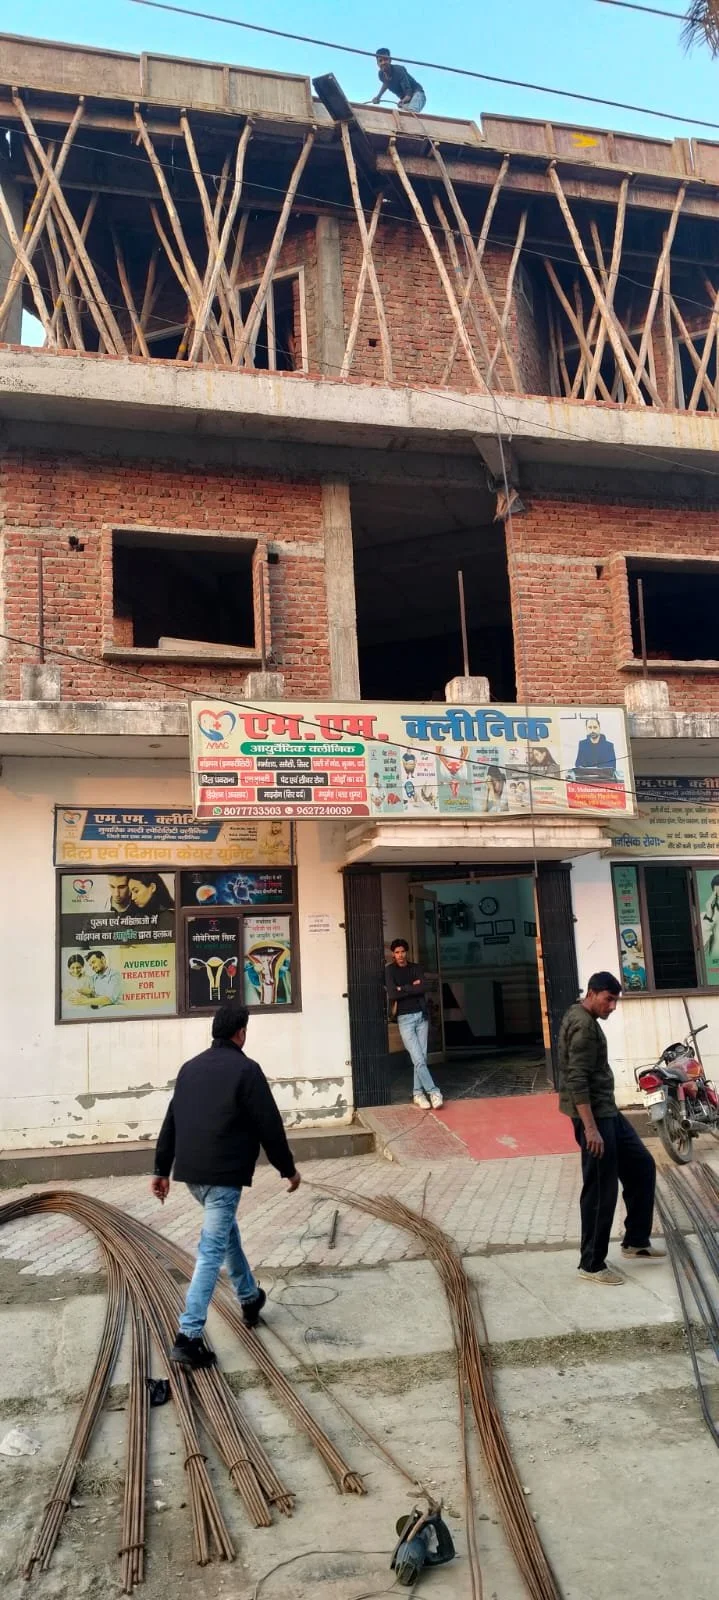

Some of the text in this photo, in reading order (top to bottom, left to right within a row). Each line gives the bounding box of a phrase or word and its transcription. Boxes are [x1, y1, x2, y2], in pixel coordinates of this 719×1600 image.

[239, 708, 552, 742] एम.एम. क्लीनिक
[250, 743, 356, 755] आयुर्वेदिक क्लीनिक
[223, 806, 282, 816] 8077733503
[296, 806, 353, 816] 9627240039
[93, 814, 149, 824] एम.एम.
[62, 842, 92, 860] दिल
[123, 842, 172, 860] दिमाग
[175, 844, 214, 860] केयर
[215, 844, 254, 864] यूनिट
[101, 932, 112, 940] का
[152, 929, 173, 940] इलाज
[123, 960, 168, 969] AYURVEDIC
[121, 970, 170, 980] TREATMENT
[138, 982, 154, 990] FOR
[122, 991, 171, 1001] INFERTILITY
